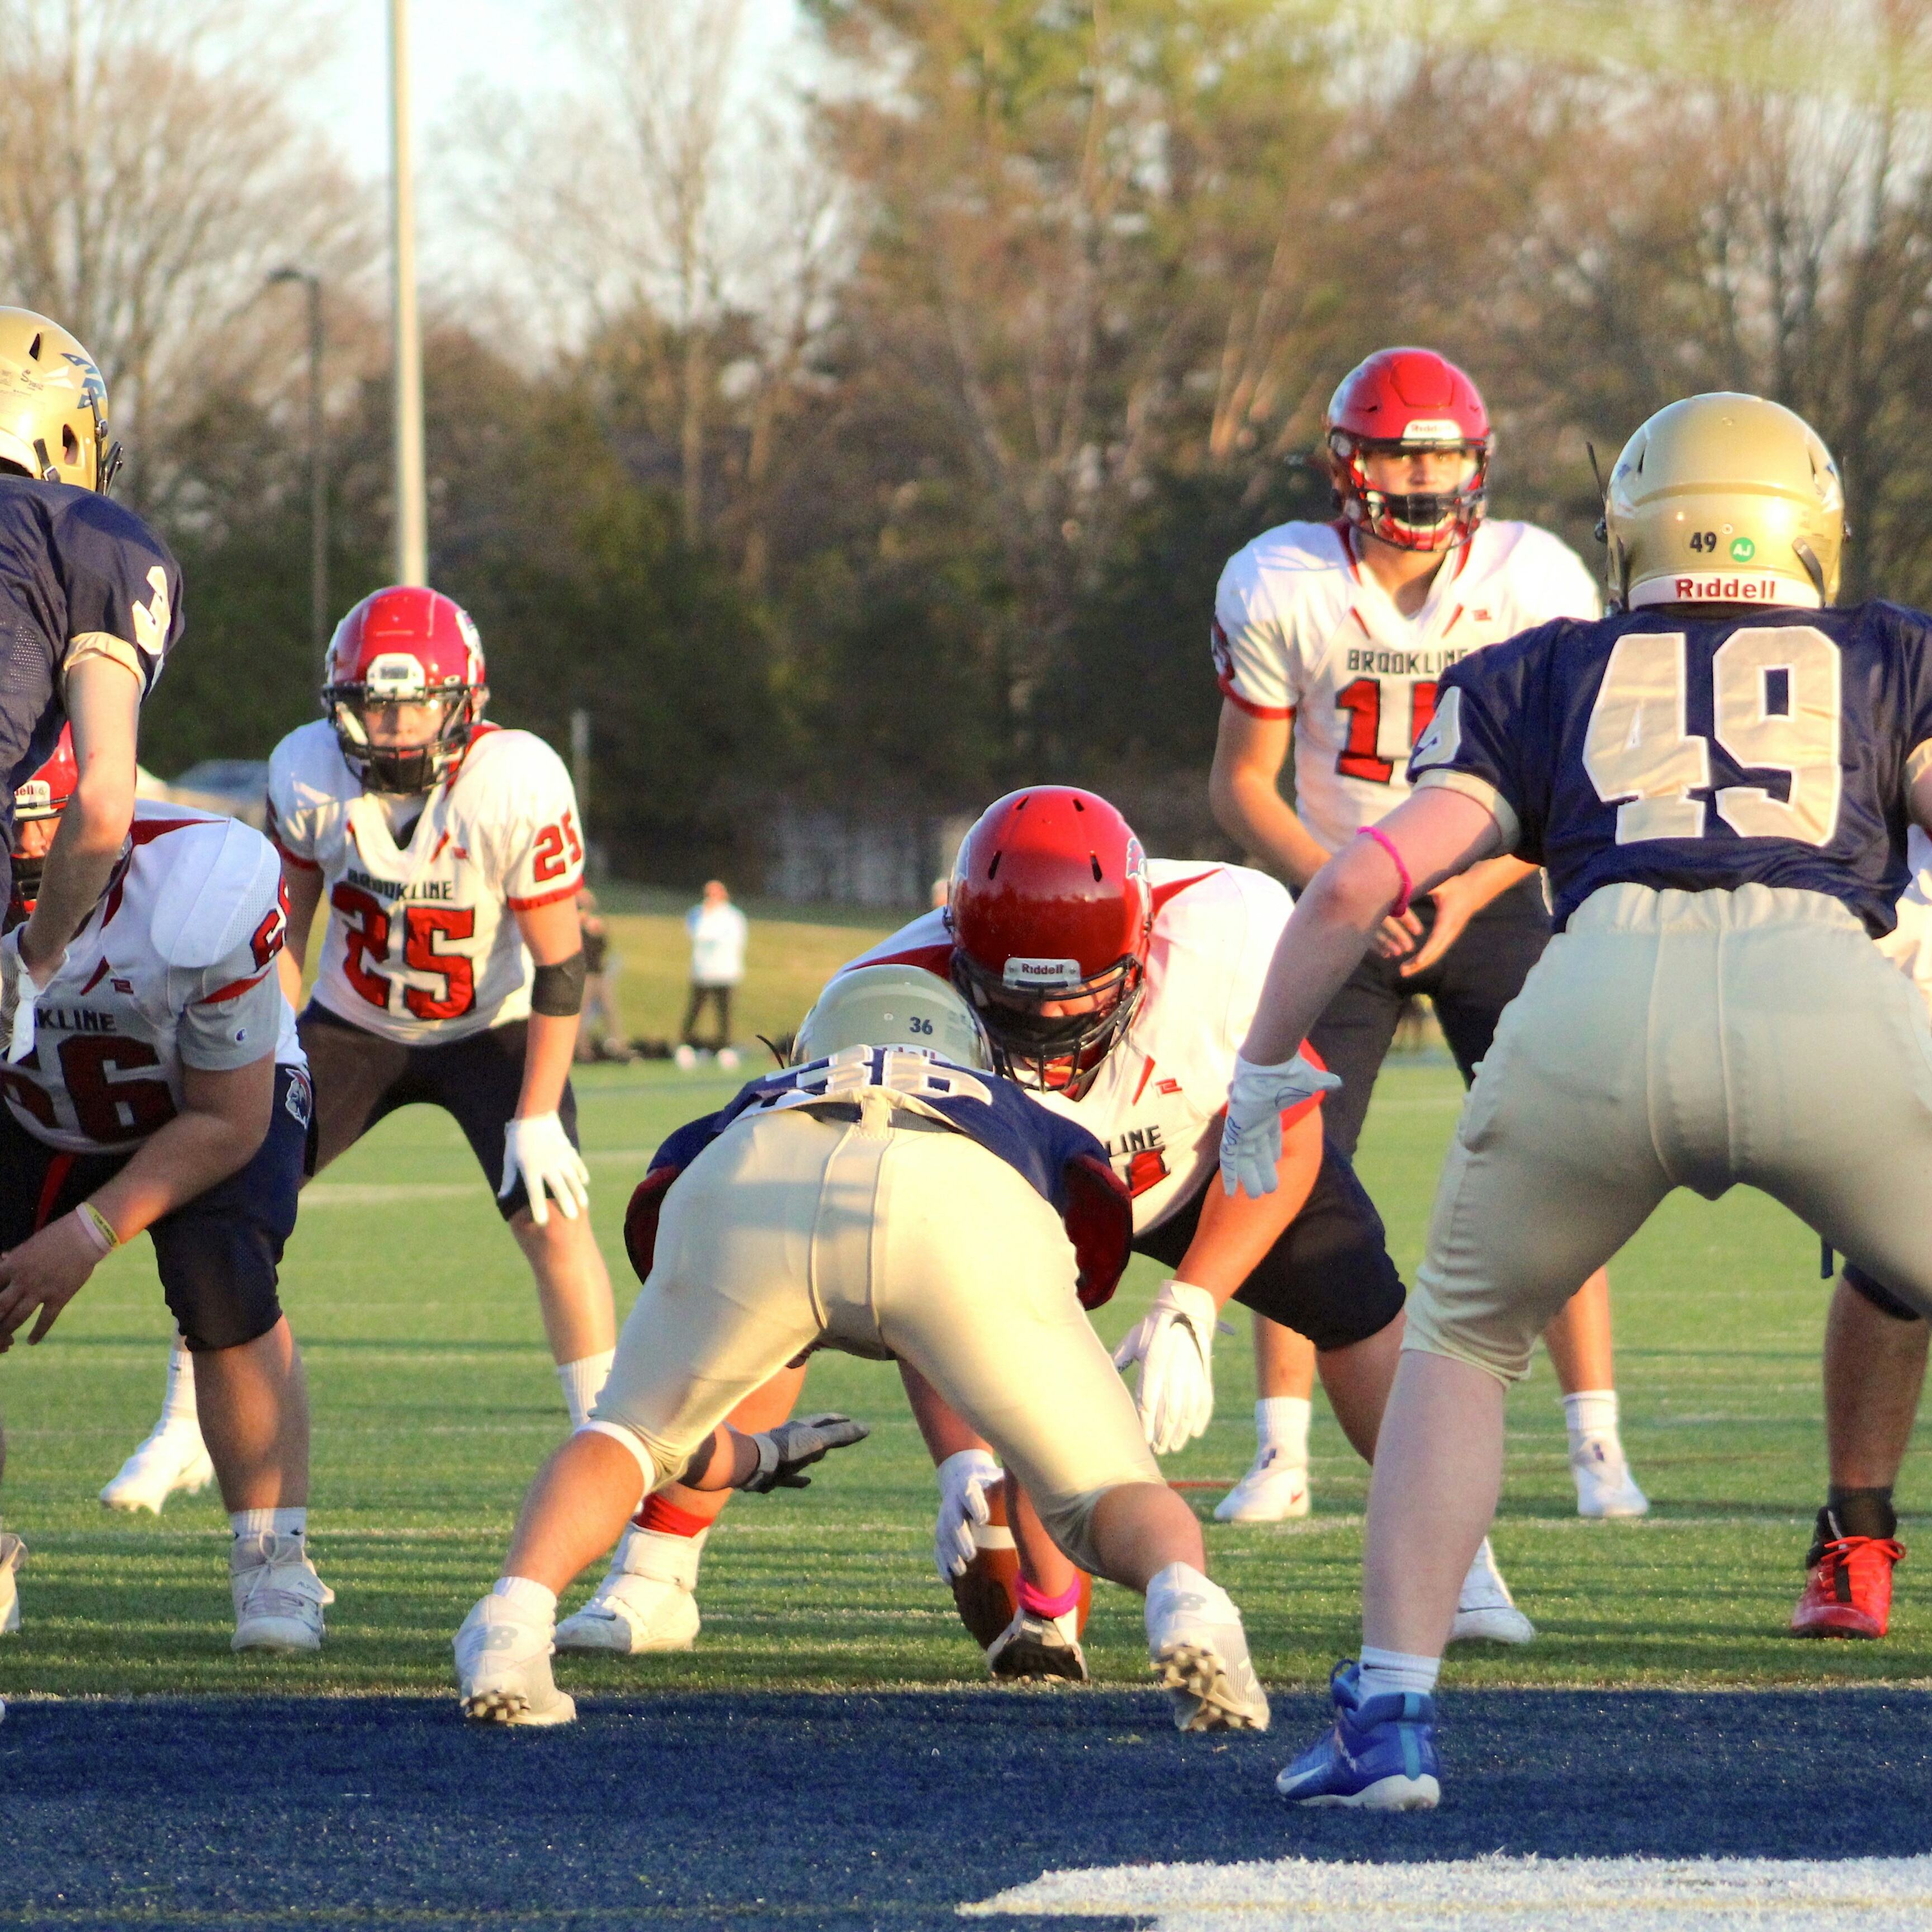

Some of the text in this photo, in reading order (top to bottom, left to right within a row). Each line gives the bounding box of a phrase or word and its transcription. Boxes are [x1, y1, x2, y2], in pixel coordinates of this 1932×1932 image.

[1689, 532, 1717, 552] 49
[1733, 544, 1753, 556] AJ
[1675, 577, 1775, 600] Riddell
[1582, 625, 1843, 847] 49
[533, 808, 581, 883] 25
[331, 880, 475, 1020] 25
[1021, 963, 1064, 974] Riddell
[35, 1007, 116, 1032] KLINE
[909, 1016, 933, 1035] 36
